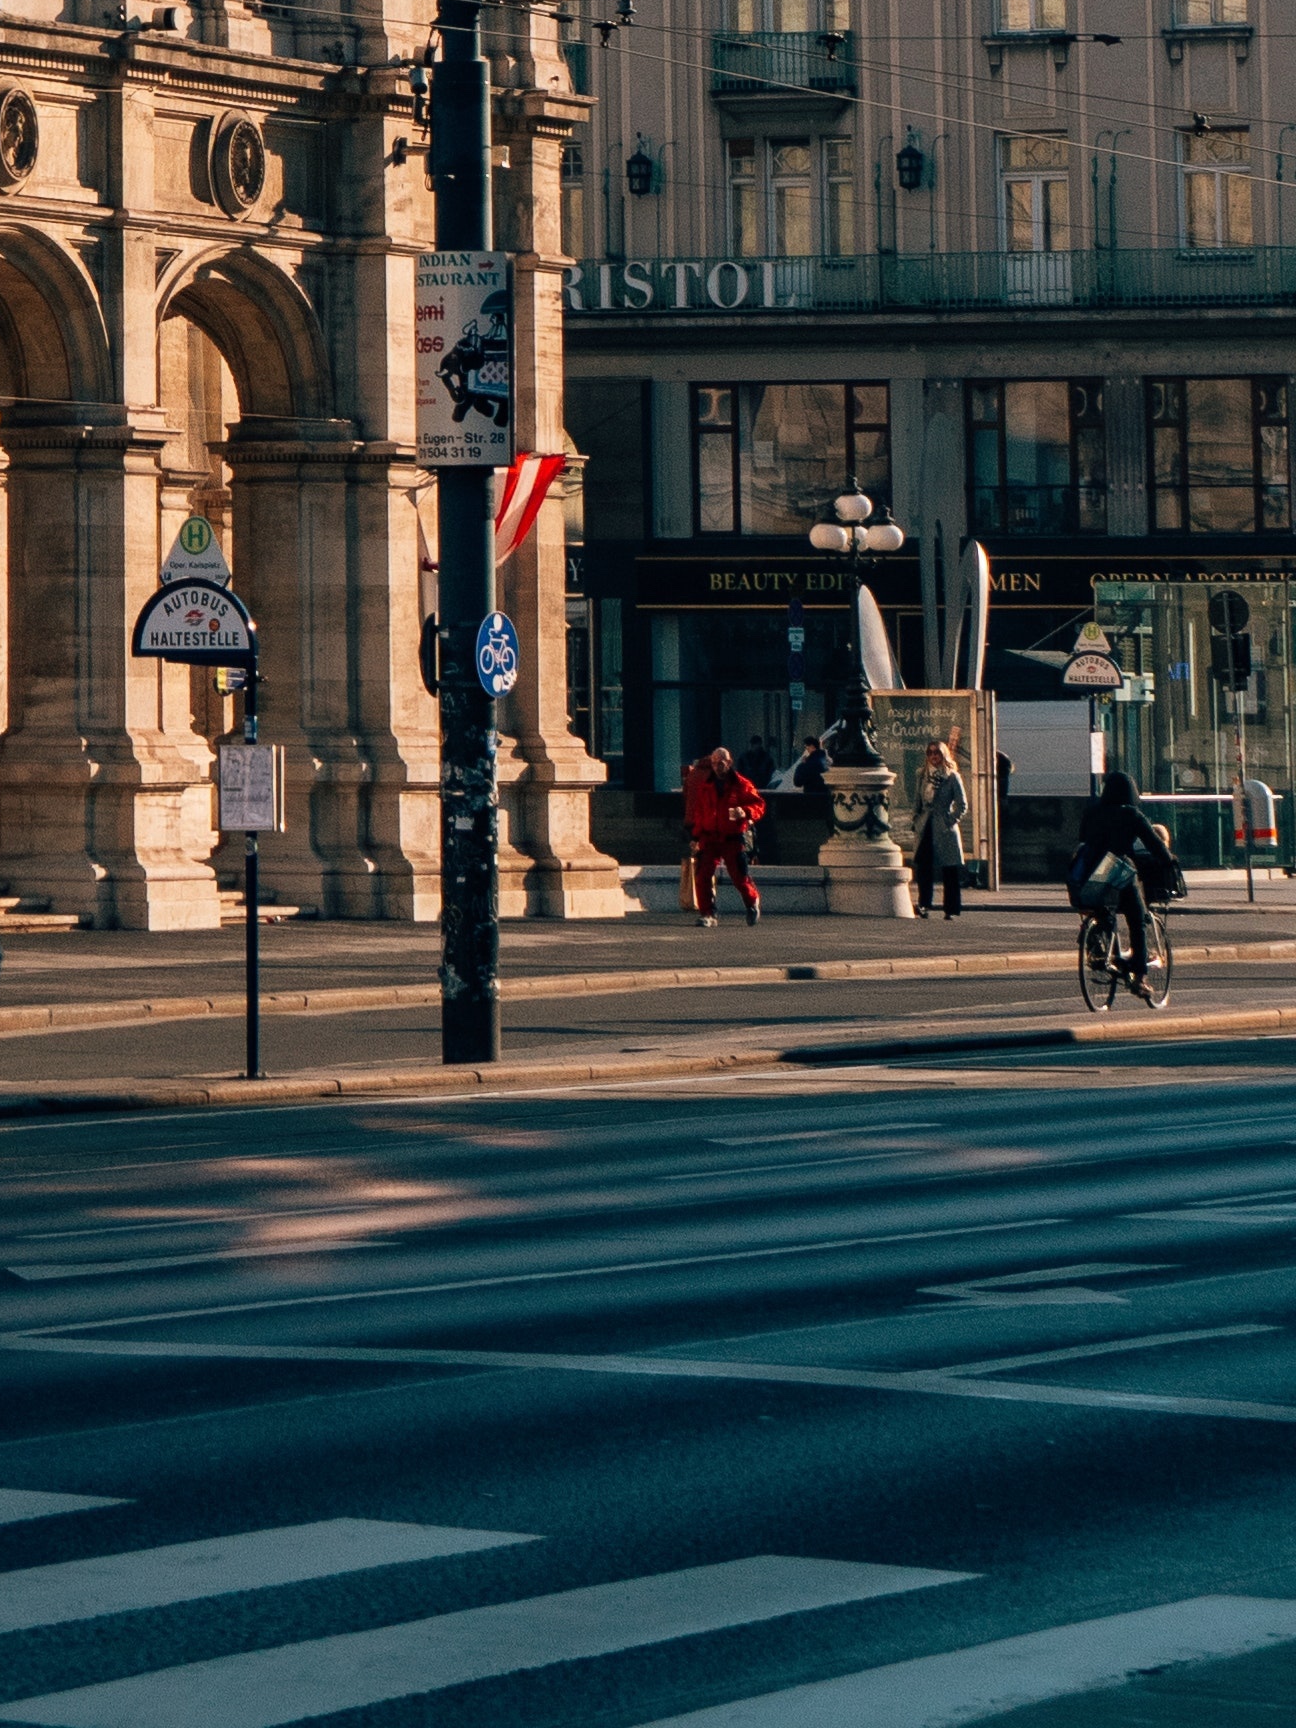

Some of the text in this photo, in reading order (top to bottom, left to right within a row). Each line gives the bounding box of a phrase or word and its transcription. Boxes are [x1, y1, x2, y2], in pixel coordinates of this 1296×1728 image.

[419, 253, 473, 268] INDIAN
[417, 272, 500, 286] STAURANT
[415, 330, 445, 353] ass
[489, 432, 506, 444] 28
[428, 447, 448, 458] 504
[188, 524, 204, 546] H
[709, 573, 853, 590] BEAUTY EDI
[163, 590, 229, 617] AUTOBUS
[151, 631, 240, 646] HALTESTELLE
[1075, 656, 1110, 670] AUTOBUS
[1068, 675, 1115, 684] HALTESTELLE
